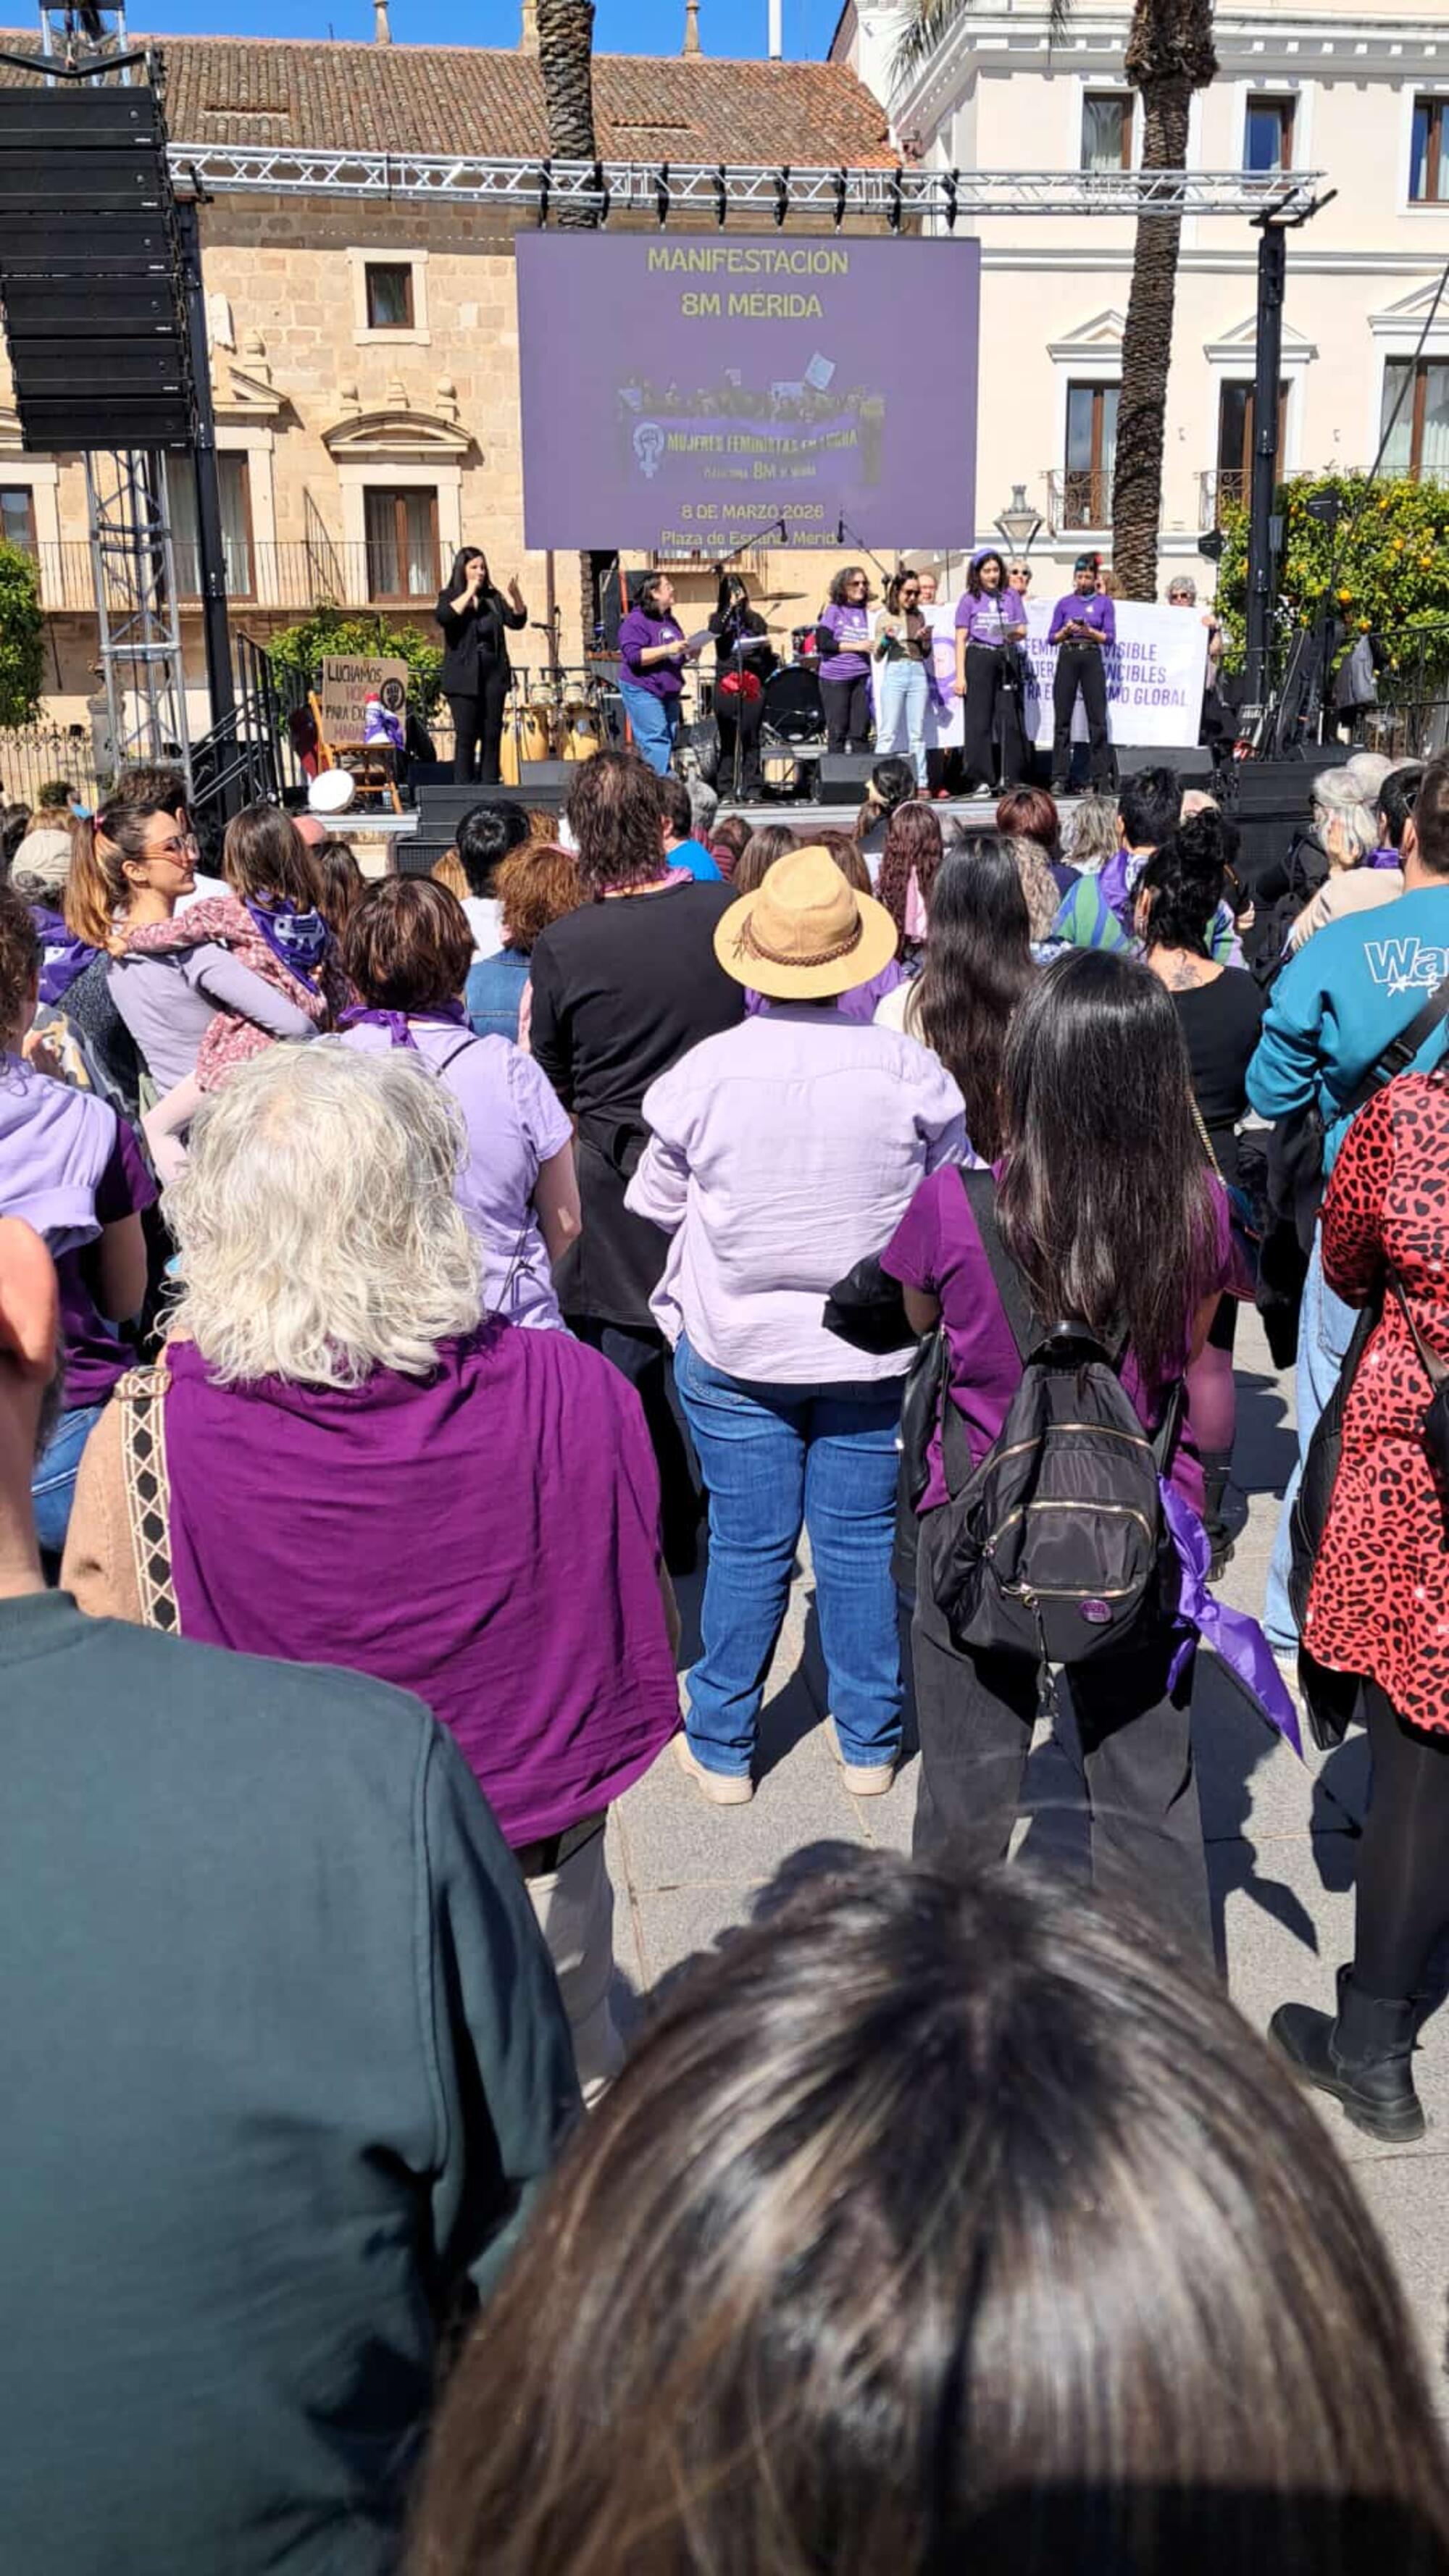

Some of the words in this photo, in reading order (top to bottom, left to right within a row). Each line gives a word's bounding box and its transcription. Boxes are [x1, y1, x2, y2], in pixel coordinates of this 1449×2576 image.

[648, 243, 849, 275] MANIFESTACIÓN
[681, 292, 722, 317] 8M
[727, 288, 823, 318] MÉRIDA
[753, 461, 776, 480] 8M
[681, 504, 693, 520] 8
[696, 504, 719, 519] DE
[722, 505, 779, 519] MARZO
[661, 530, 703, 545] Plaza
[706, 531, 724, 545] de
[327, 661, 383, 684] LUCHAMOS
[1134, 687, 1186, 707] GLOBAL
[325, 705, 348, 720] PARA
